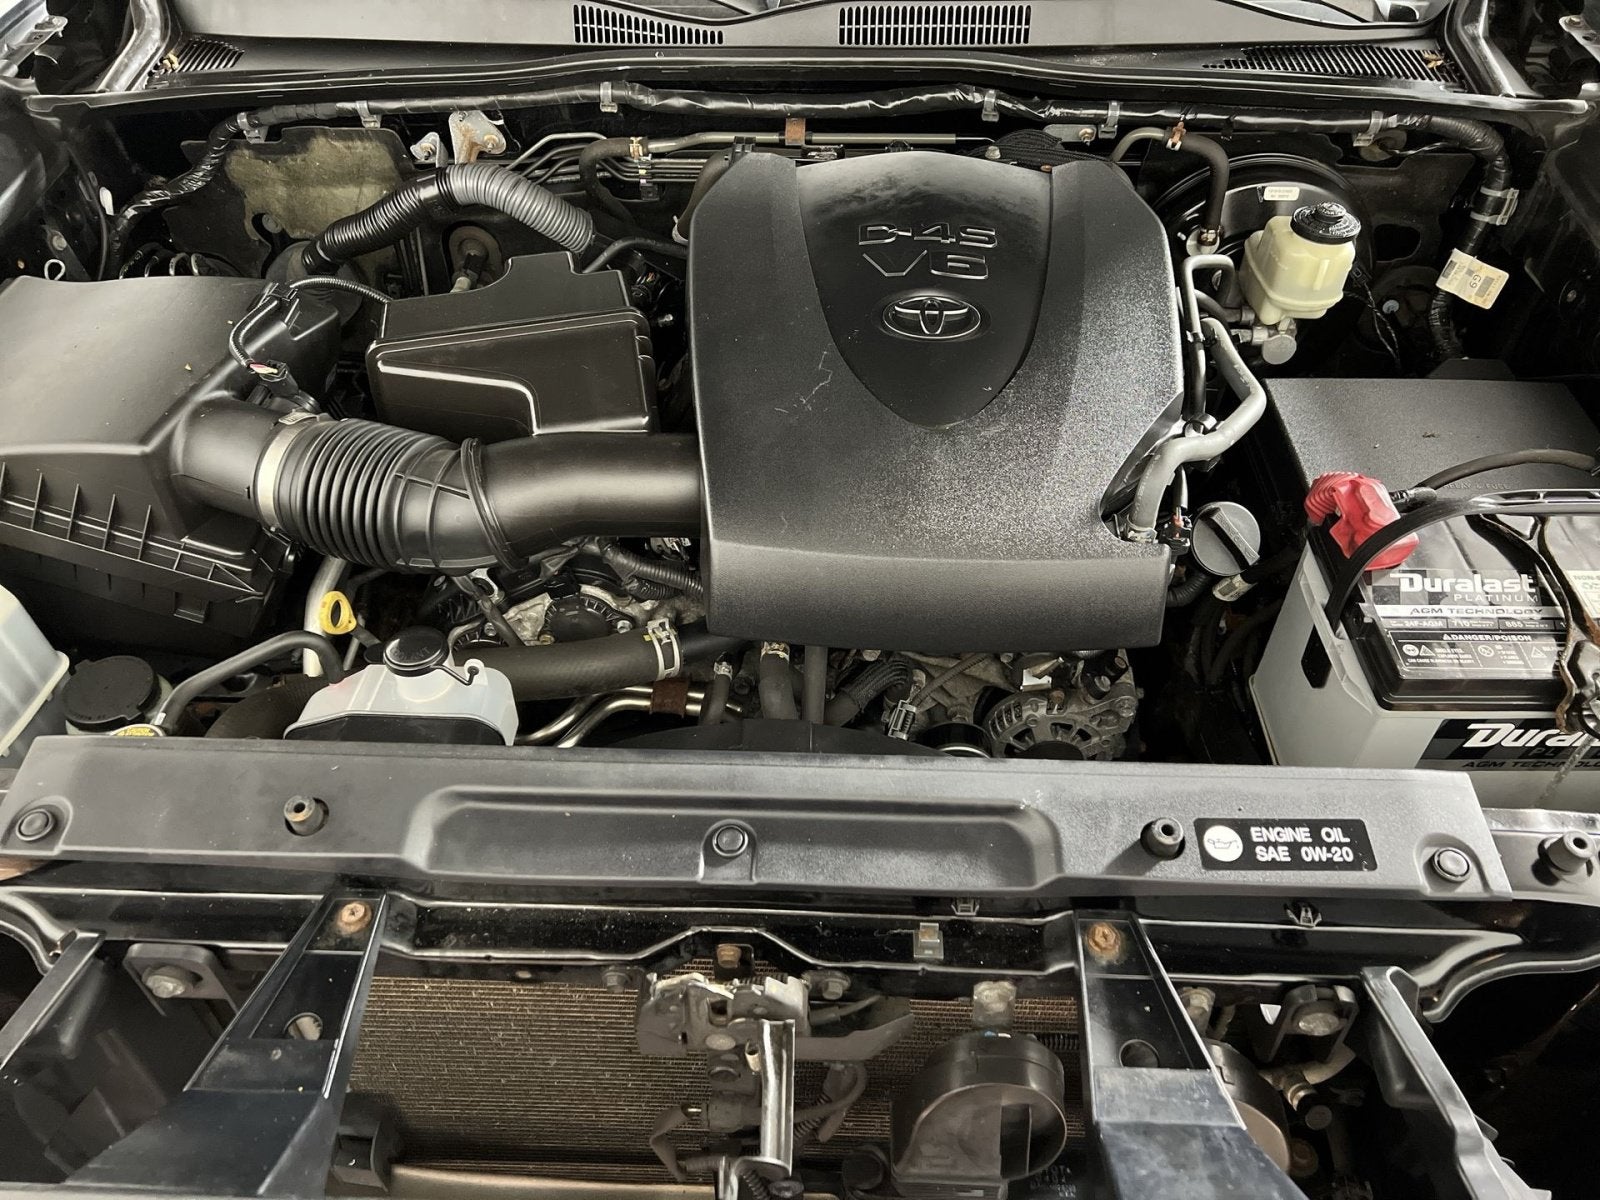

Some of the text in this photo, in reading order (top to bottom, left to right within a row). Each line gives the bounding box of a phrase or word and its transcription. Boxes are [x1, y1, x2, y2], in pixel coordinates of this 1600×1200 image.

[858, 222, 998, 249] D-4S
[862, 249, 989, 280] V6
[1390, 573, 1536, 593] Duralast
[1453, 593, 1539, 602] PLATINUM
[1410, 607, 1443, 615] AGM
[1452, 633, 1532, 641] DANGER/POISON
[1250, 826, 1350, 843] ENGINE OIL
[1255, 846, 1353, 862] SAE 0W-20
